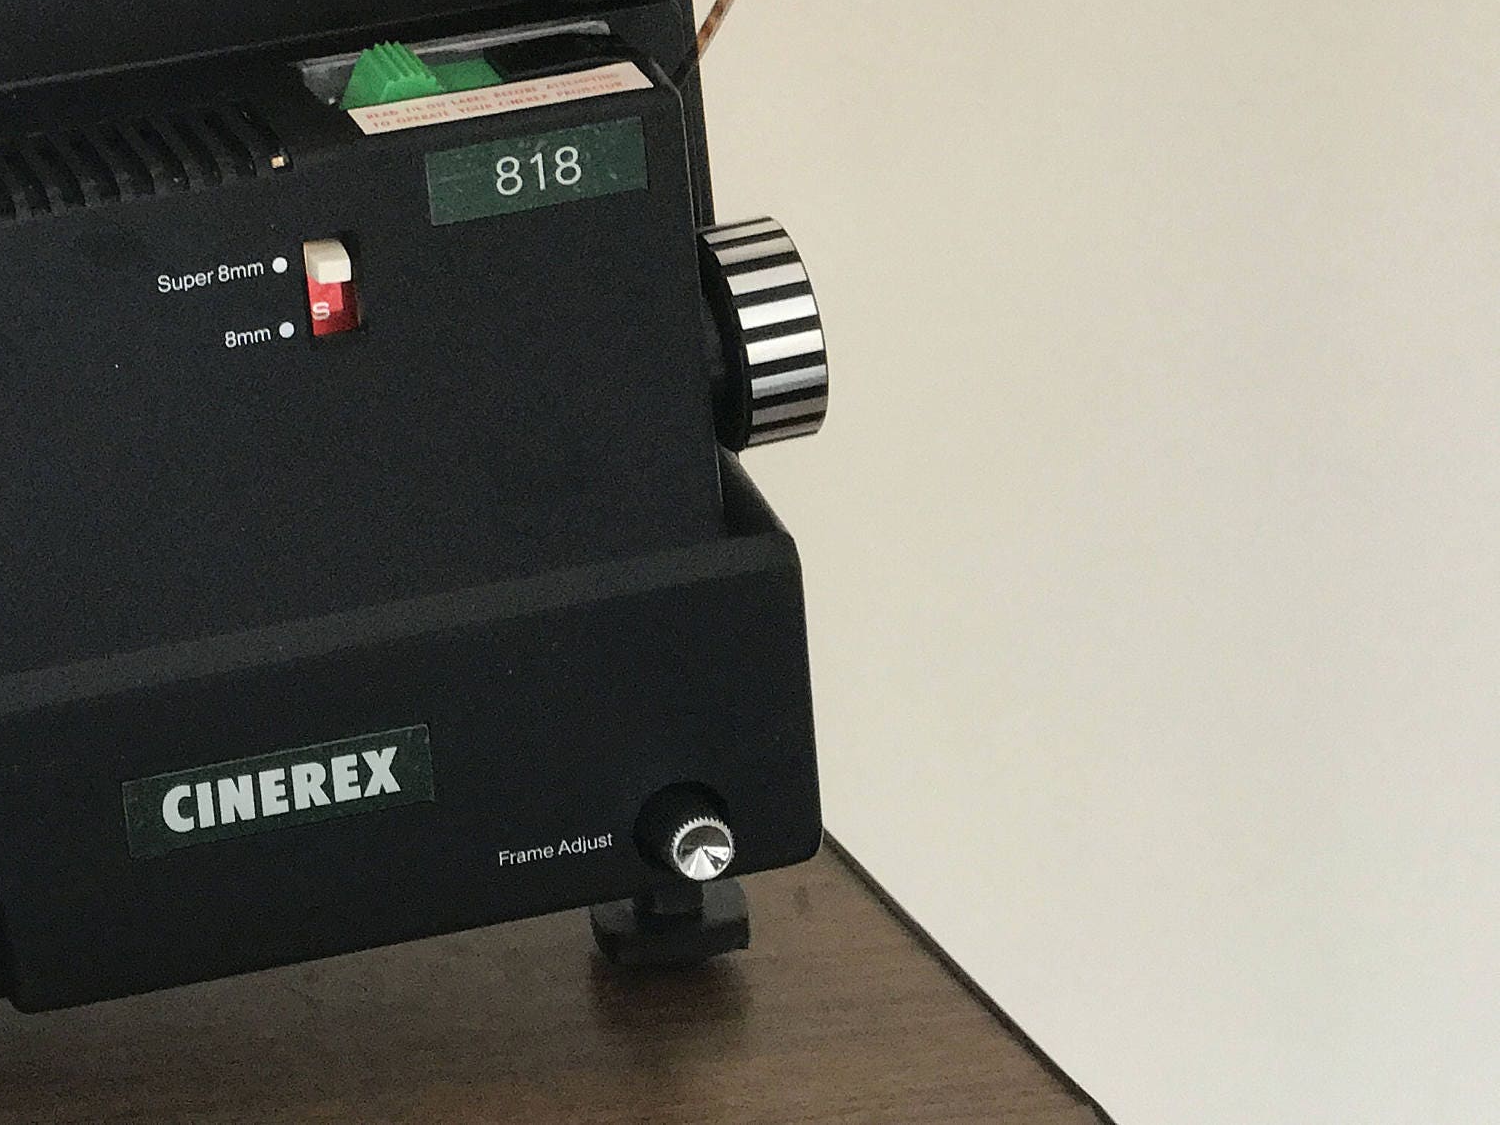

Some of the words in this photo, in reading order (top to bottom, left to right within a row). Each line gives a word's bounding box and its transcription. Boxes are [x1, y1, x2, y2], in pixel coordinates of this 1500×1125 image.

[496, 146, 582, 196] 818
[157, 269, 215, 293] Super
[218, 262, 265, 283] 8mm
[312, 302, 331, 321] S
[225, 328, 271, 348] 8mm
[162, 746, 402, 833] CINEREX
[498, 845, 555, 867] Frame
[558, 832, 613, 856] Adjust
